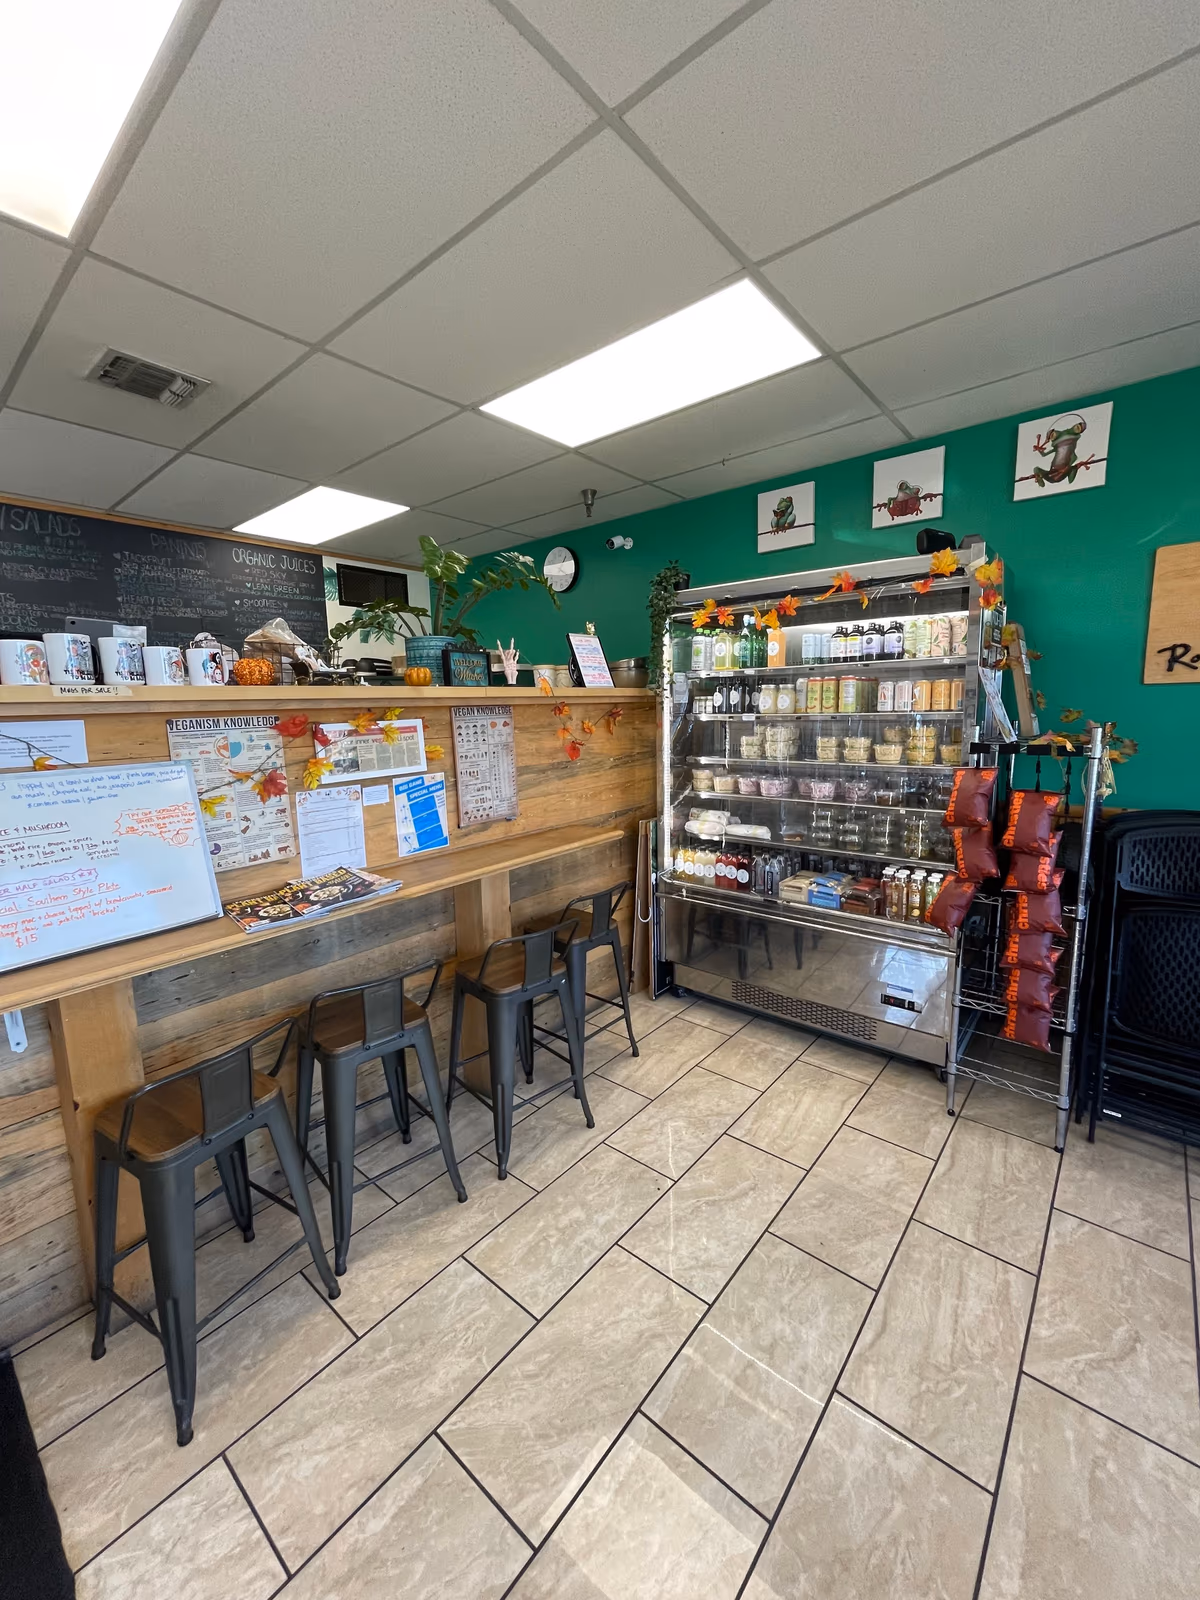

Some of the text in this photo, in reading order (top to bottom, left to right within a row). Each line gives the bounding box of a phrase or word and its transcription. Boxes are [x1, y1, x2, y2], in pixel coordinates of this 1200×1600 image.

[10, 508, 81, 537] SALADS
[121, 550, 171, 567] JACKFRUIT
[232, 547, 317, 575] ORGANIC JUICES
[251, 567, 288, 580] RED SKY
[252, 582, 300, 595] LEAN GREEN
[242, 598, 283, 609] SMOOTHIES
[60, 687, 79, 695] MUGS
[81, 686, 92, 695] FOR
[453, 705, 512, 717] VEGAN KNOWLEDGE
[168, 715, 280, 731] VEGANISM KNOWLEDGE
[409, 783, 443, 799] SPECIAL MENU
[23, 821, 70, 834] MUSHROOM
[1002, 791, 1026, 848] christies
[315, 868, 347, 885] BASED
[1036, 856, 1051, 890] sties
[15, 882, 38, 892] HALF
[43, 875, 76, 887] SALADS
[27, 892, 69, 907] Southern
[72, 886, 95, 899] Style
[97, 882, 121, 892] Plate
[15, 933, 39, 949] $15
